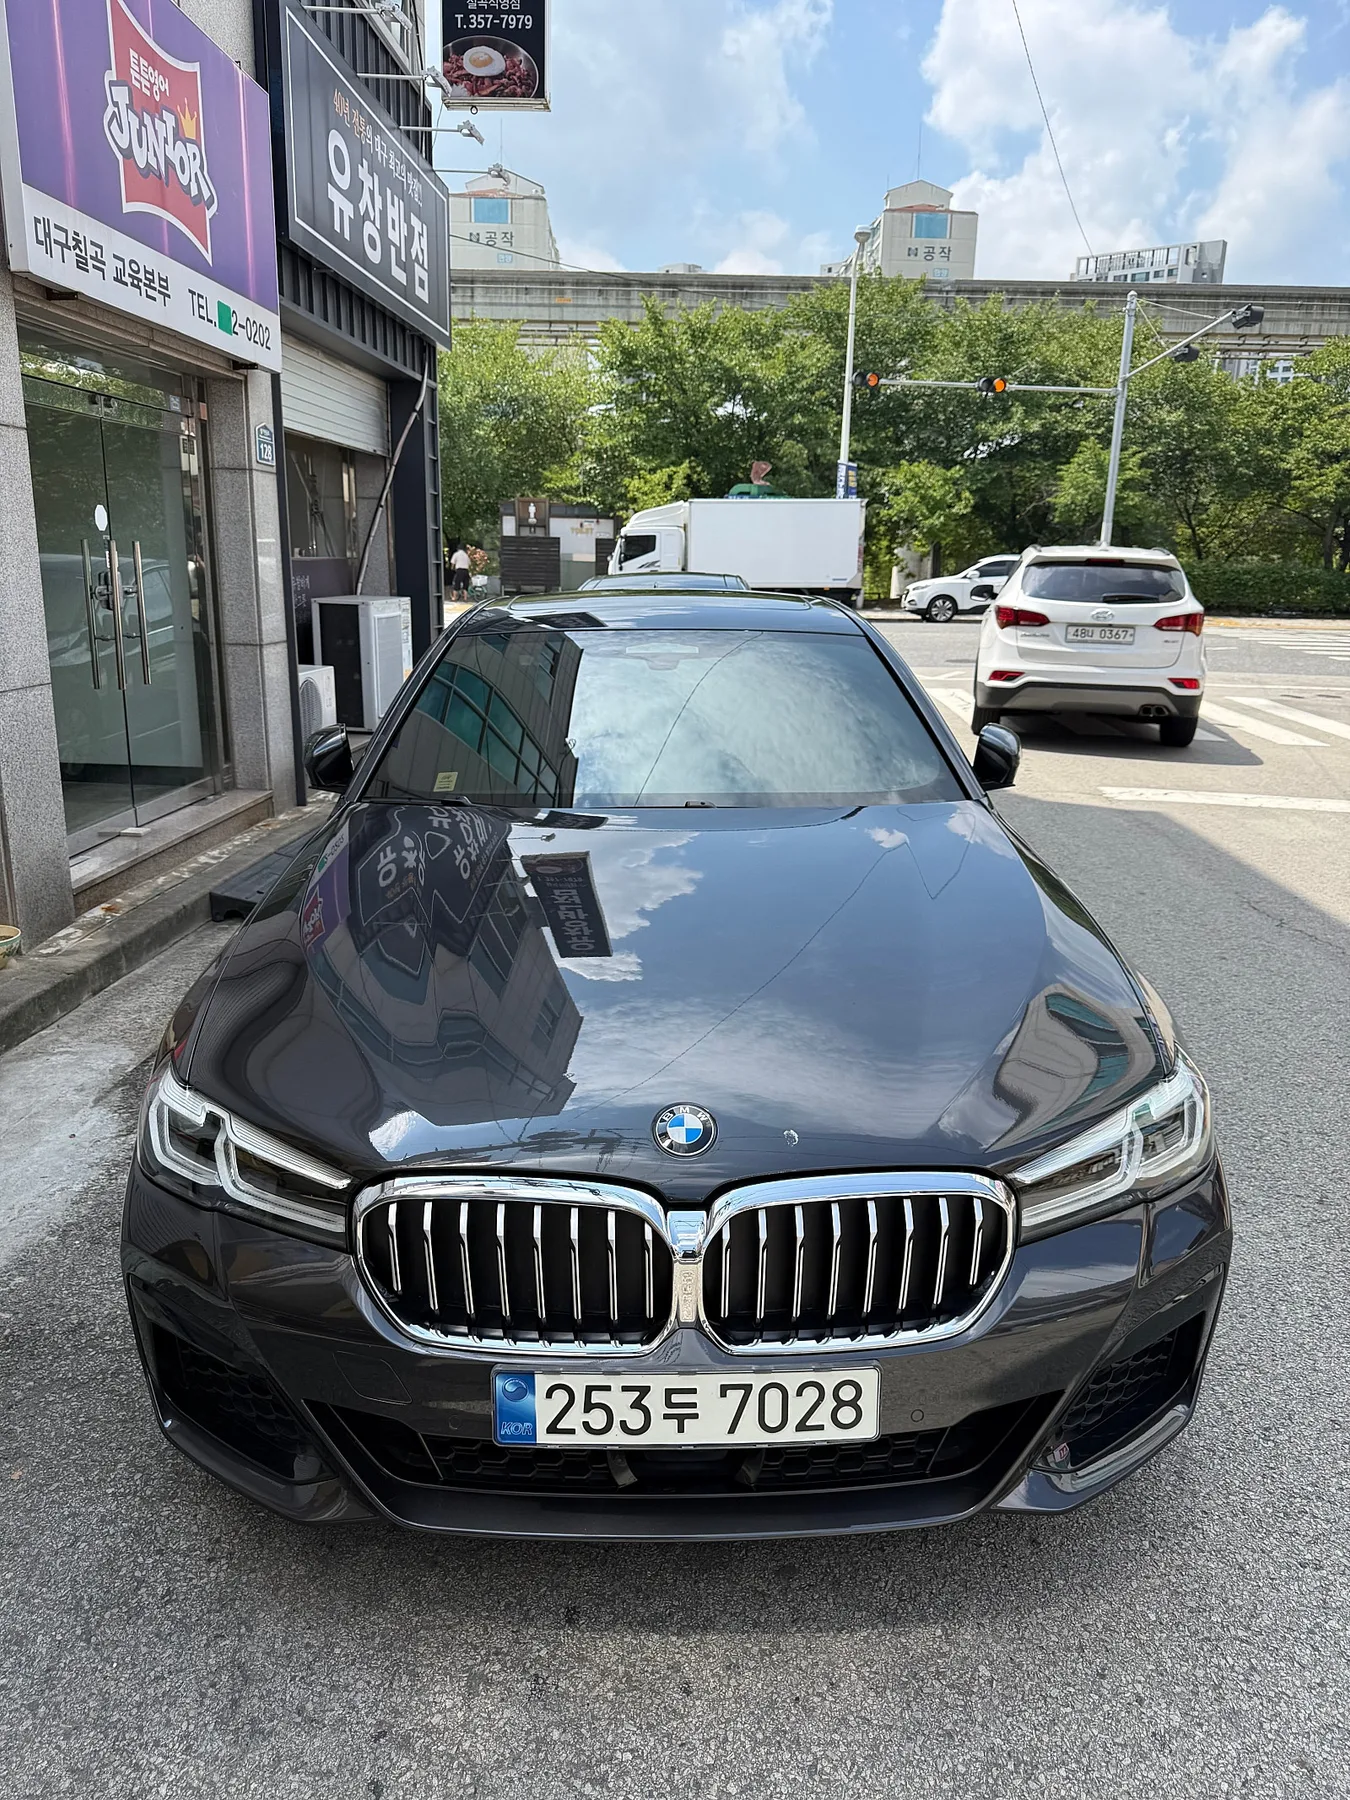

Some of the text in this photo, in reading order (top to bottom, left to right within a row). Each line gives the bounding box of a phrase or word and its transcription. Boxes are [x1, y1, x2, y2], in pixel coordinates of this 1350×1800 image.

[454, 14, 533, 29] T.357-7979
[129, 48, 170, 102] 튼튼영어
[109, 85, 212, 202] JUNIOR
[333, 88, 351, 127] 40년
[352, 108, 373, 153] 전통의
[374, 134, 388, 168] 대구
[389, 149, 407, 190] 최고의
[327, 129, 429, 304] 유창반점
[485, 231, 514, 247] 공작
[33, 216, 106, 281] 대구칠곡
[112, 253, 171, 307] 교육본부
[923, 246, 952, 261] 공작
[260, 443, 272, 460] 128
[1099, 628, 1128, 640] 0367
[662, 1106, 709, 1121] BMW
[545, 1379, 863, 1436] 253두 7028
[500, 1421, 533, 1436] KOR
